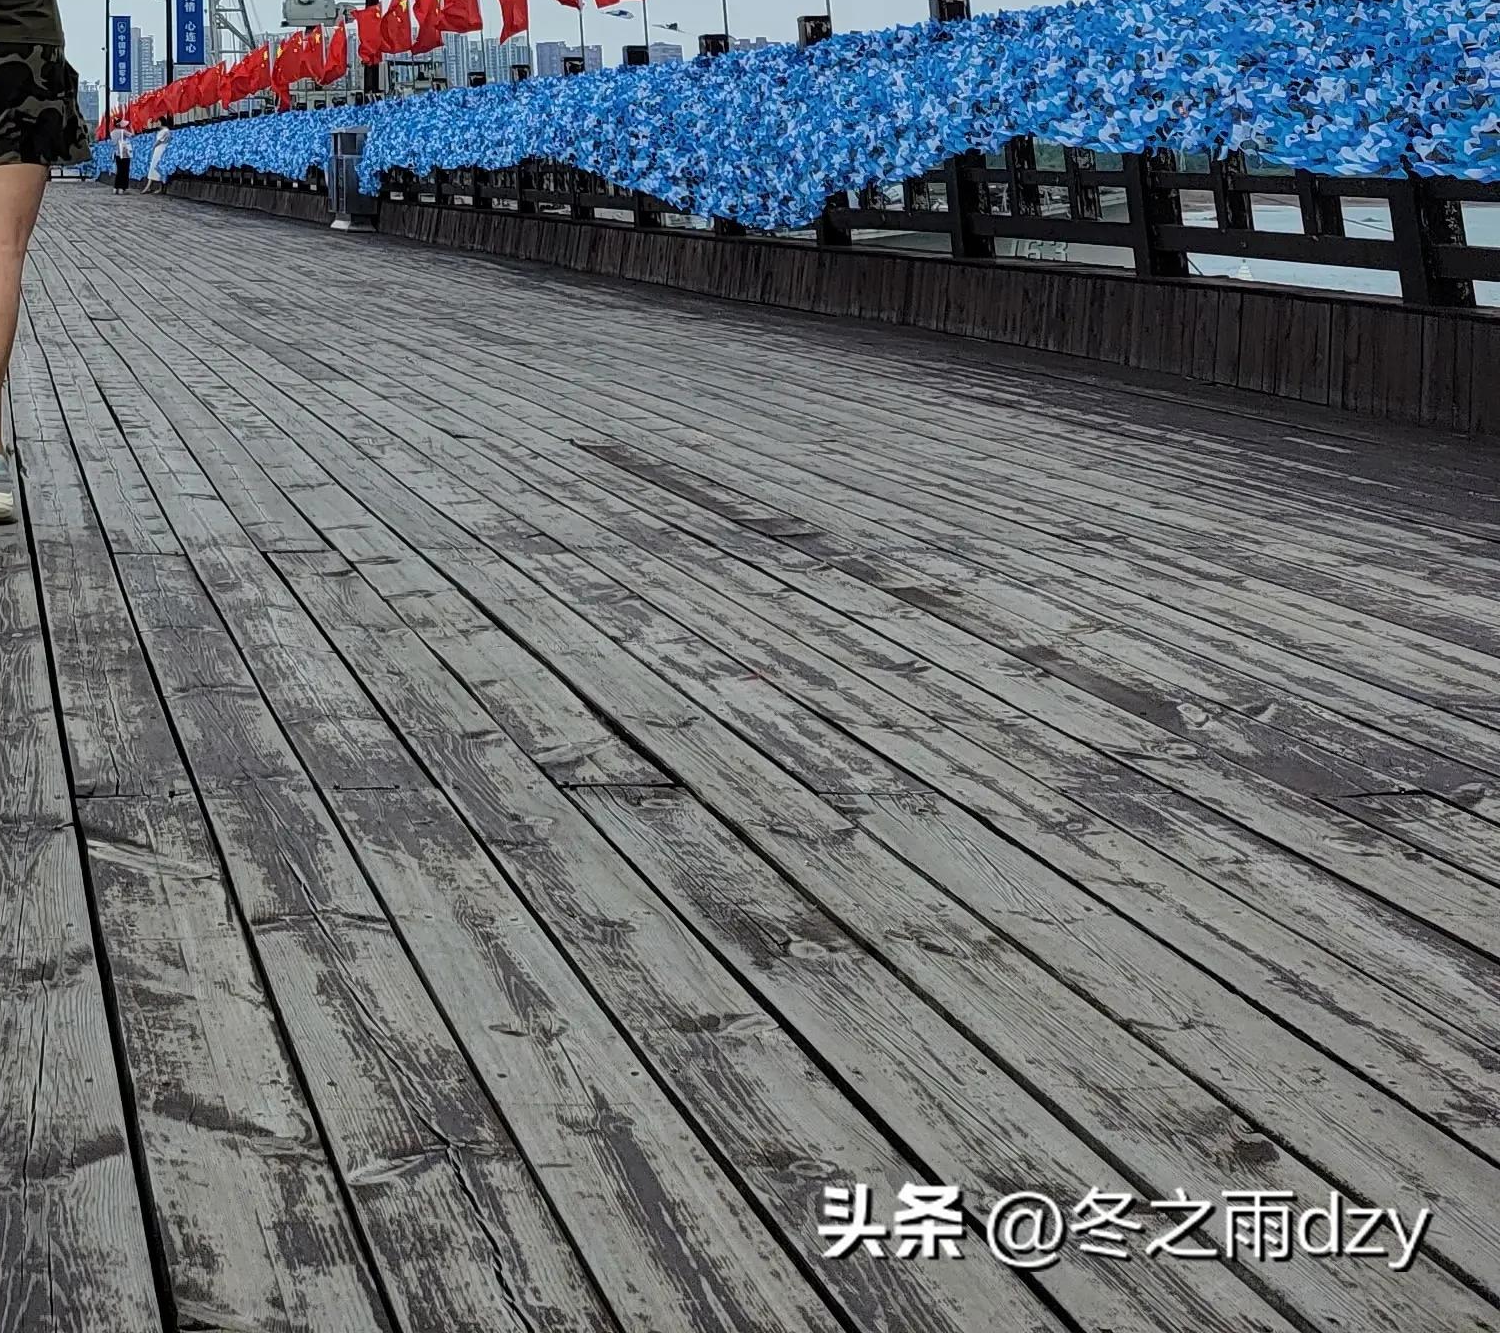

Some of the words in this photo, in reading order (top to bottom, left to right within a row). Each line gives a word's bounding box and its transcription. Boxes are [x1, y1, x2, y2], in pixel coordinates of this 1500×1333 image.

[117, 34, 127, 57] 中国梦
[184, 20, 197, 54] 心连心
